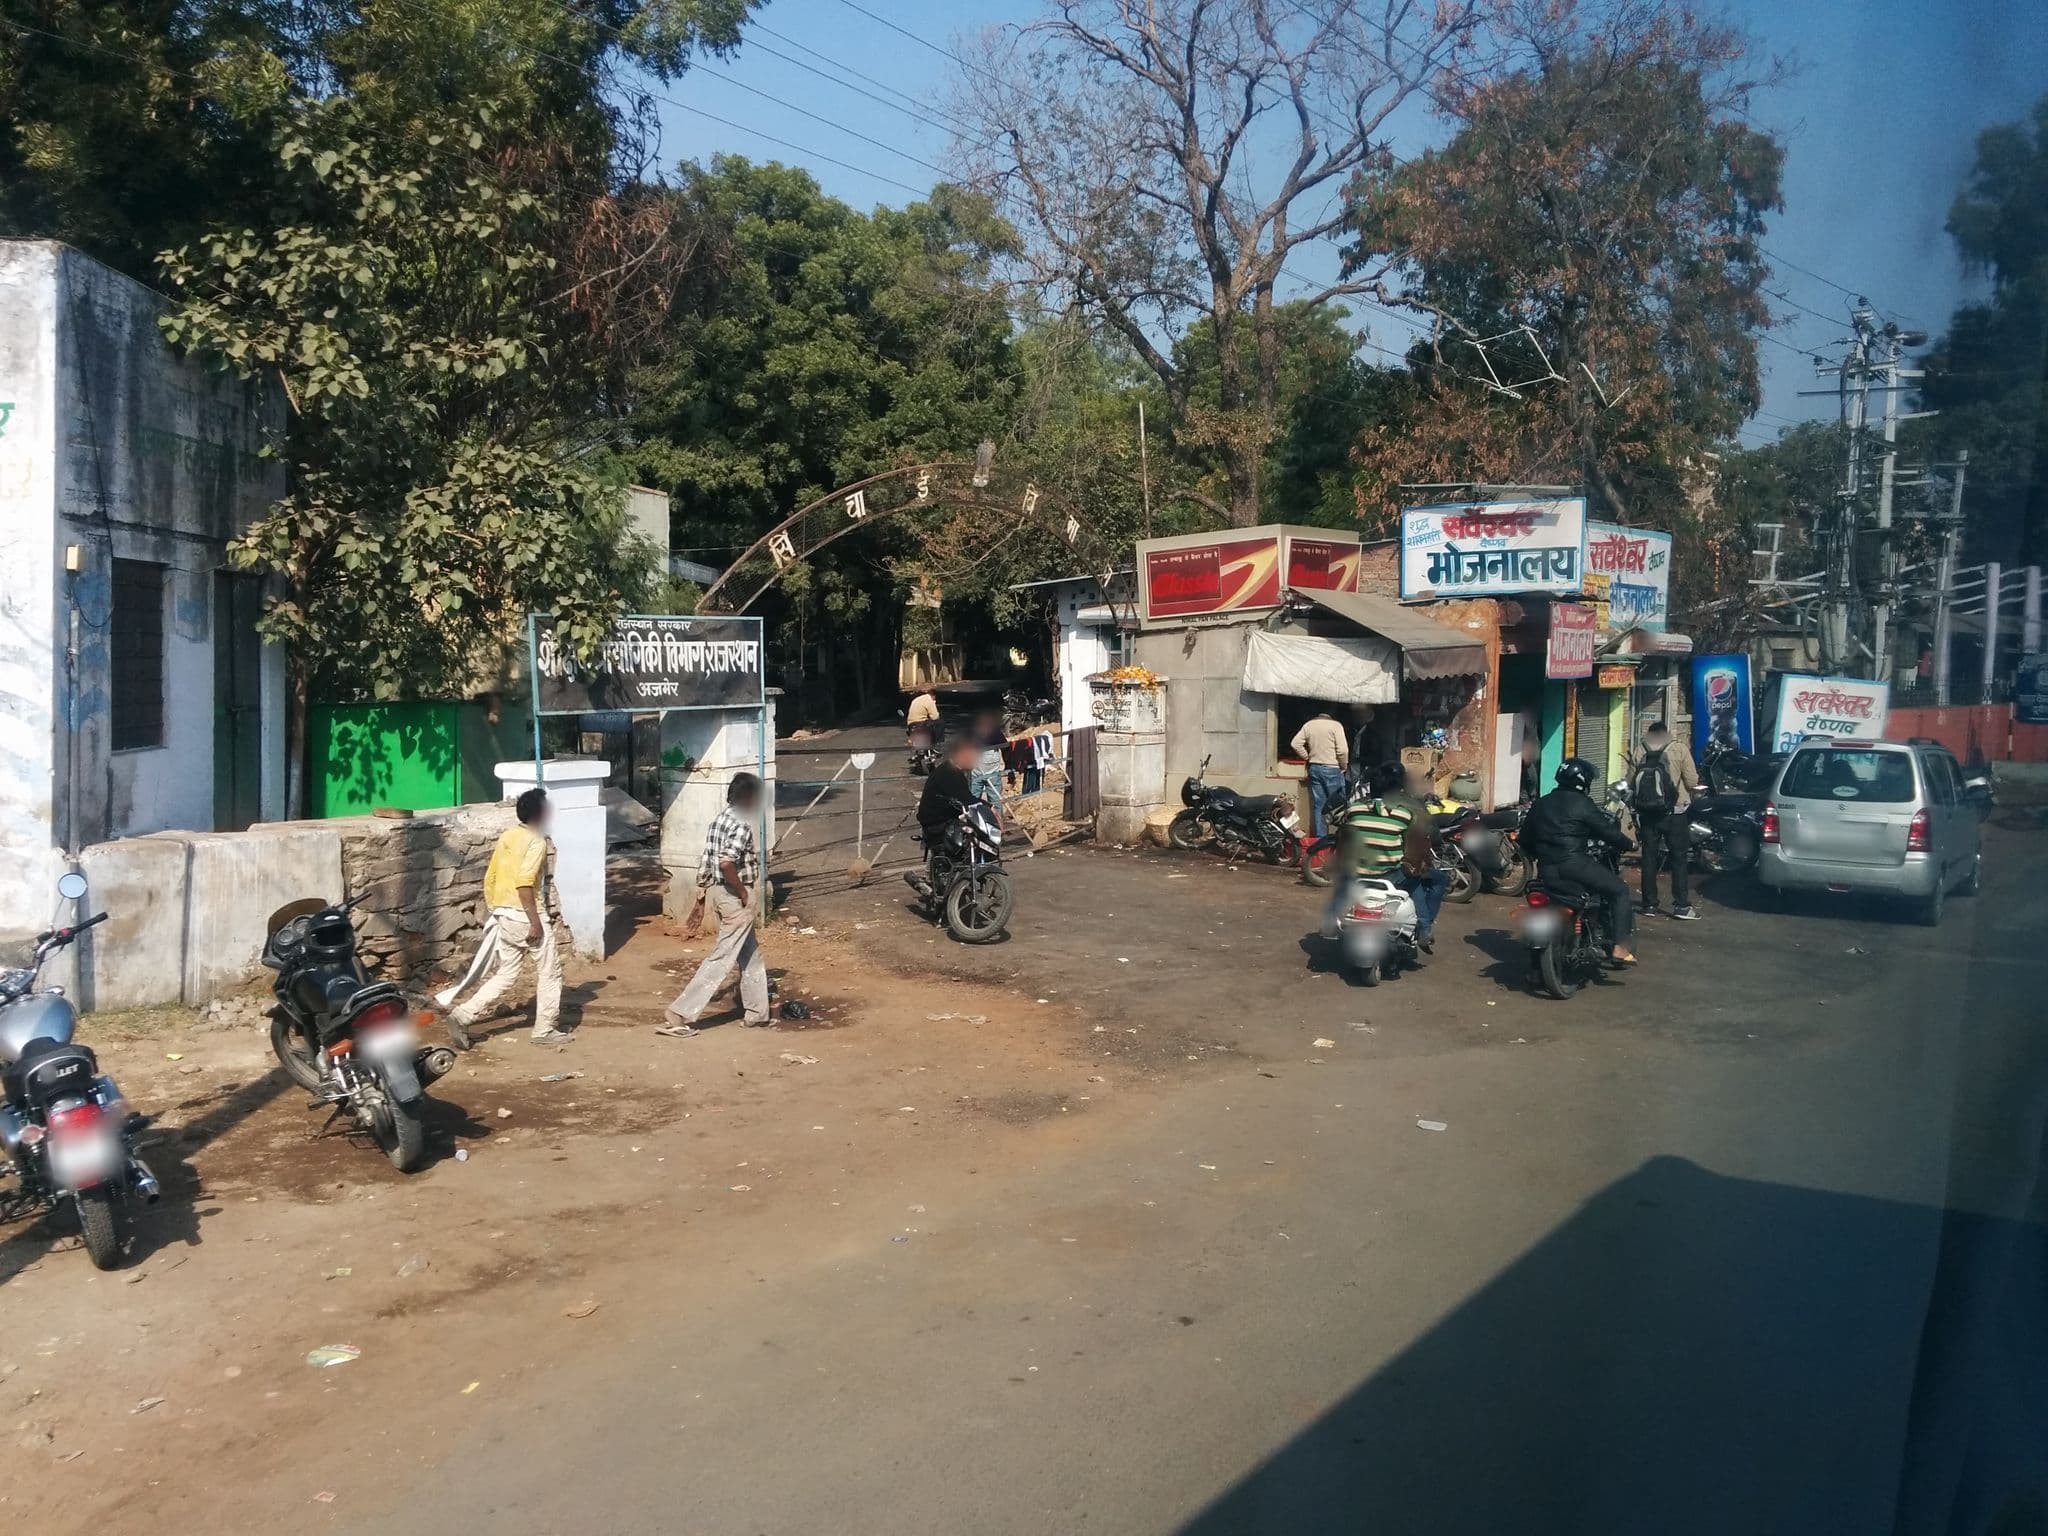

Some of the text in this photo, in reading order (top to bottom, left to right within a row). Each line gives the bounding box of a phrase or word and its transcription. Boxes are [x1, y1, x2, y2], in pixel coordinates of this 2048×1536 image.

[1427, 541, 1578, 585] भोजनालय
[1589, 533, 1649, 574] सर्वेश्वर
[615, 618, 692, 631] राजस्थान सरकार
[706, 639, 759, 674] राजस्थान
[635, 677, 679, 697] अजमेर
[1711, 702, 1732, 710] pepsi
[1806, 714, 1862, 734] वैष्णव
